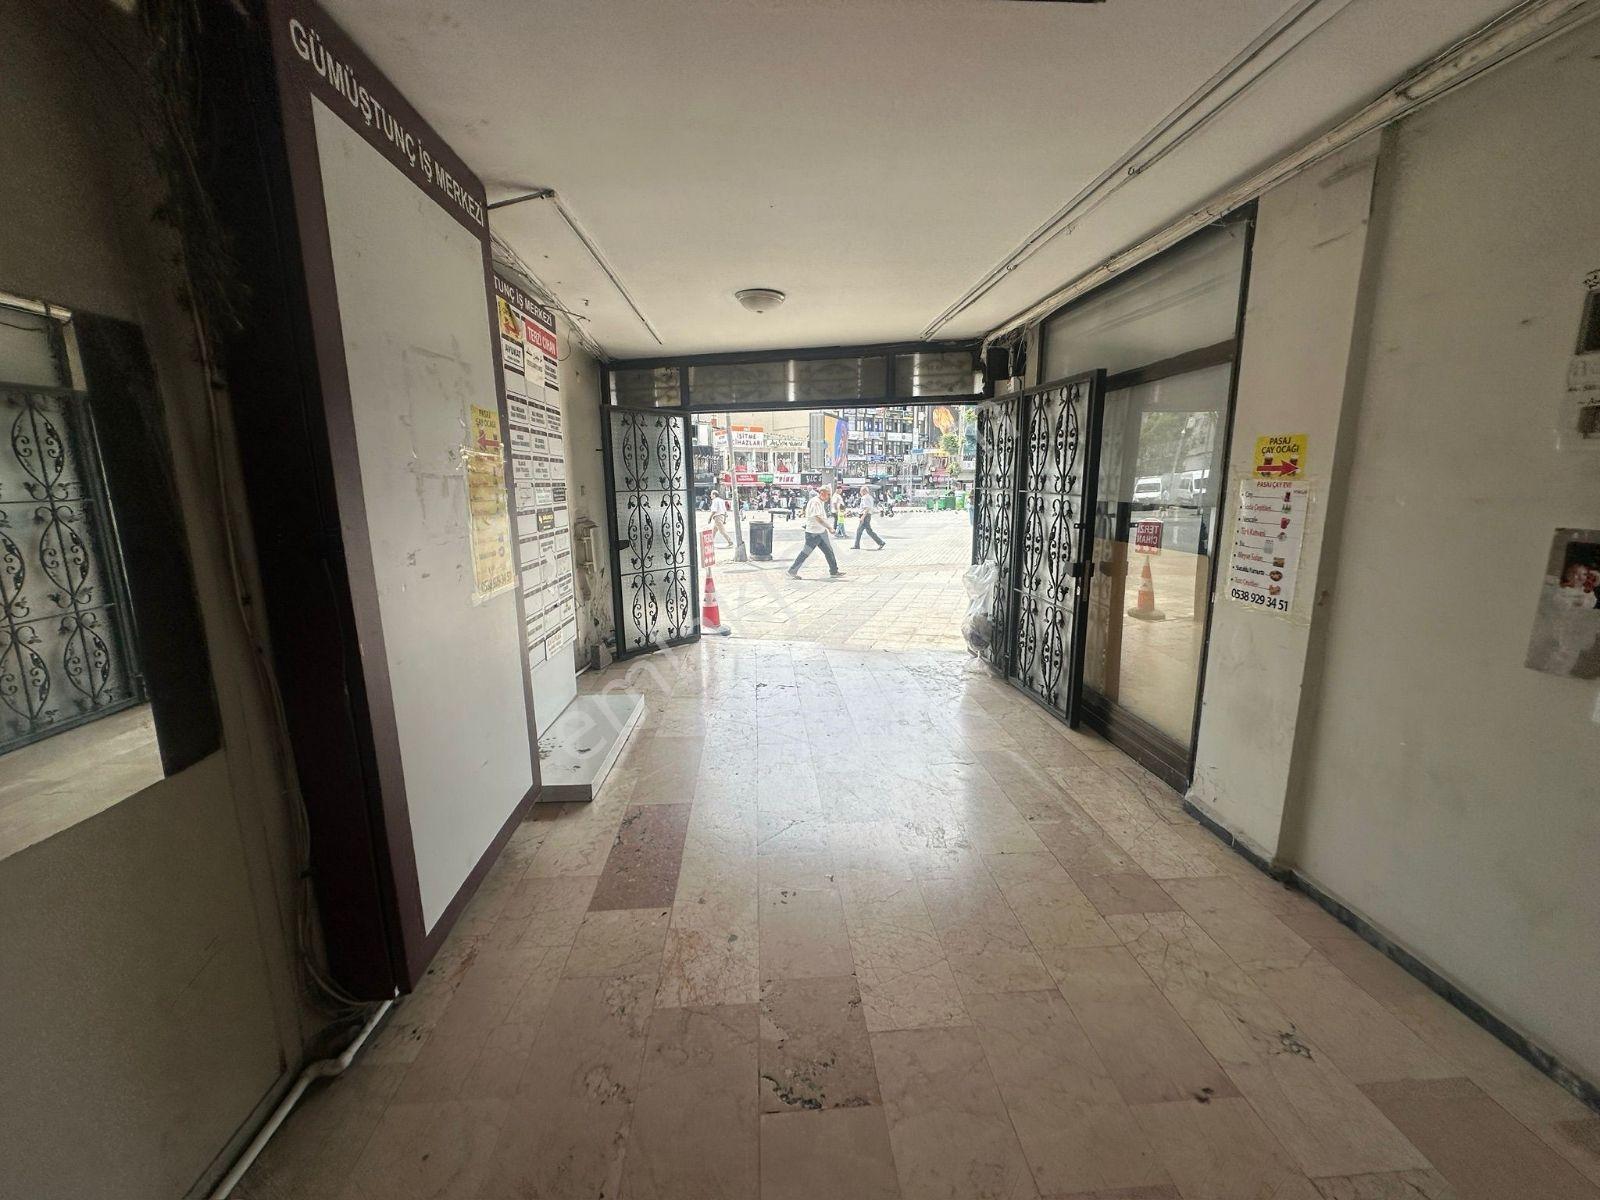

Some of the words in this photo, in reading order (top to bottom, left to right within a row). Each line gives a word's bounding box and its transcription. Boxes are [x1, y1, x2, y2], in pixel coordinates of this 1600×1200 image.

[290, 18, 416, 167] GÜMÜŞTUNÇ
[418, 139, 432, 182] İŞ
[435, 161, 484, 227] MERKEZİ
[1261, 446, 1275, 457] ÇAY
[1275, 443, 1300, 454] OCAĞI
[1269, 436, 1292, 446] PASAJ
[1231, 588, 1249, 602] 0538
[1250, 592, 1265, 605] 929
[1266, 596, 1277, 609] 34
[1278, 599, 1289, 612] 51
